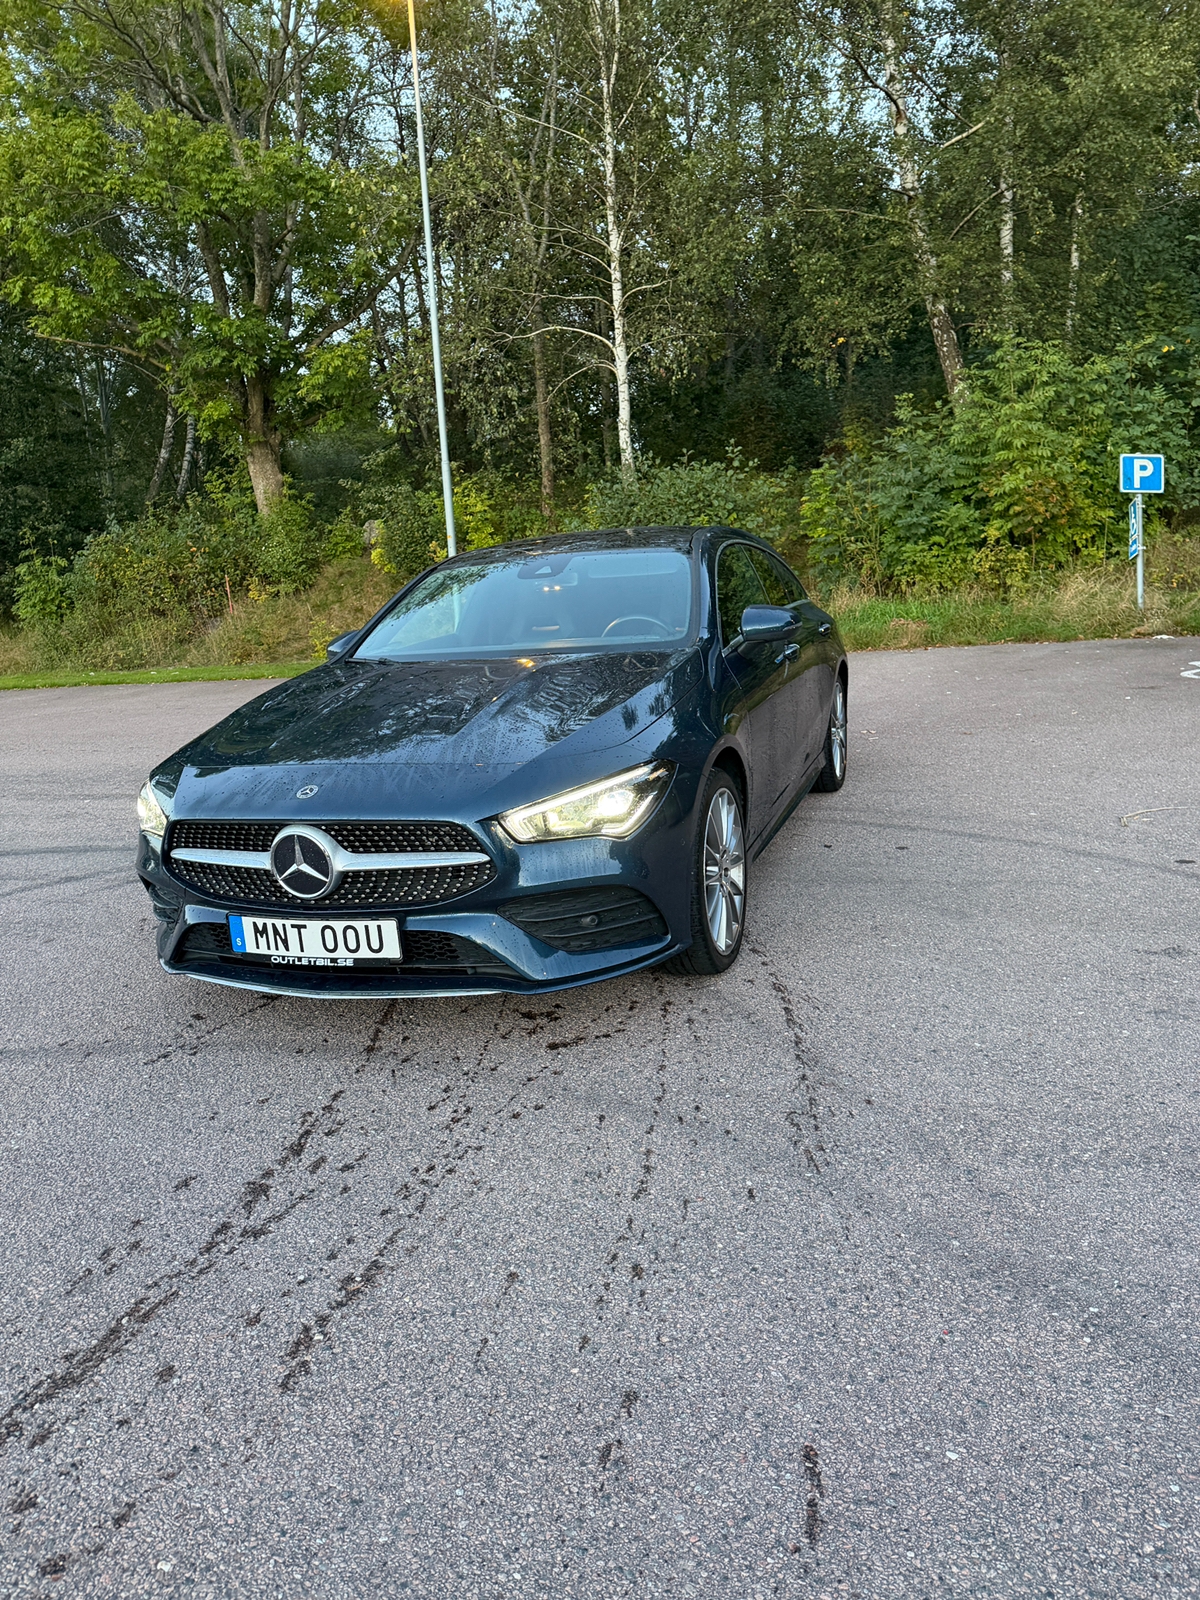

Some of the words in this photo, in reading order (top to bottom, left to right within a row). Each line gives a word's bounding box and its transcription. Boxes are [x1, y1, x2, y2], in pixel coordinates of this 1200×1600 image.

[1134, 459, 1154, 488] P
[236, 938, 242, 946] S
[252, 921, 308, 953] MNT
[271, 956, 354, 966] OUTLETBIL.SE
